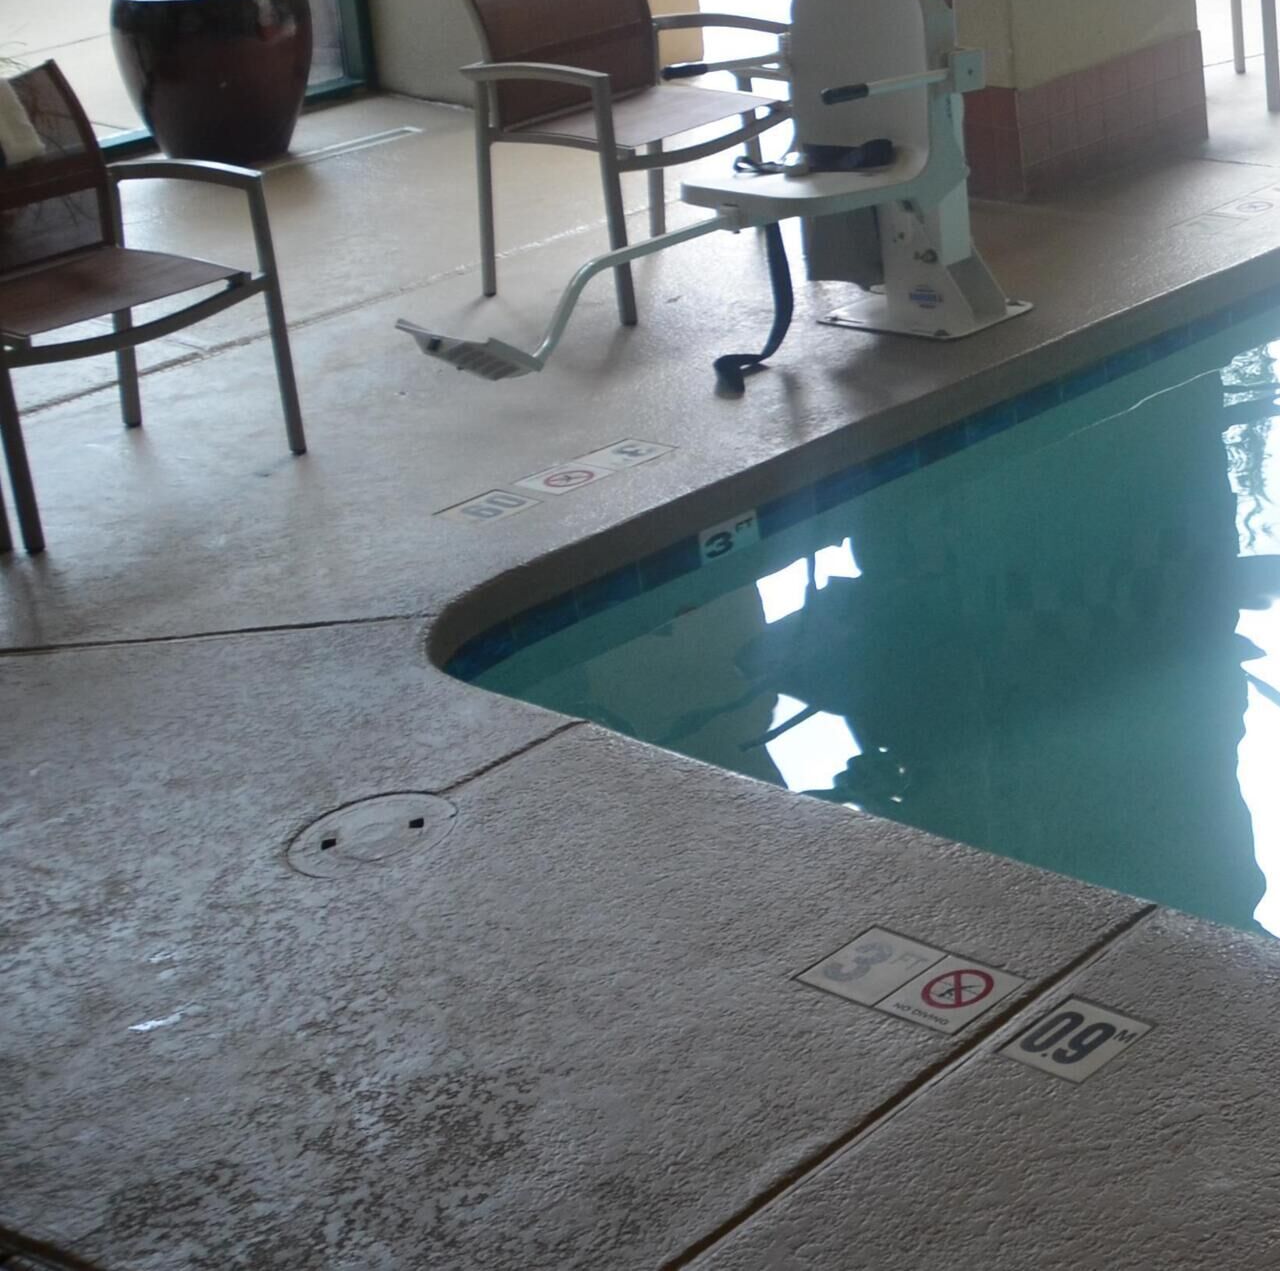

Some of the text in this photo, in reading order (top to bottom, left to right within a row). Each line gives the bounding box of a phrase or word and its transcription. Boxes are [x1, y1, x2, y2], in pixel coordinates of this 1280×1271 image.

[704, 530, 735, 559] 3
[822, 941, 898, 983] 3
[893, 1001, 950, 1026] NO DIVING
[1020, 1010, 1139, 1065] 0.9 M
